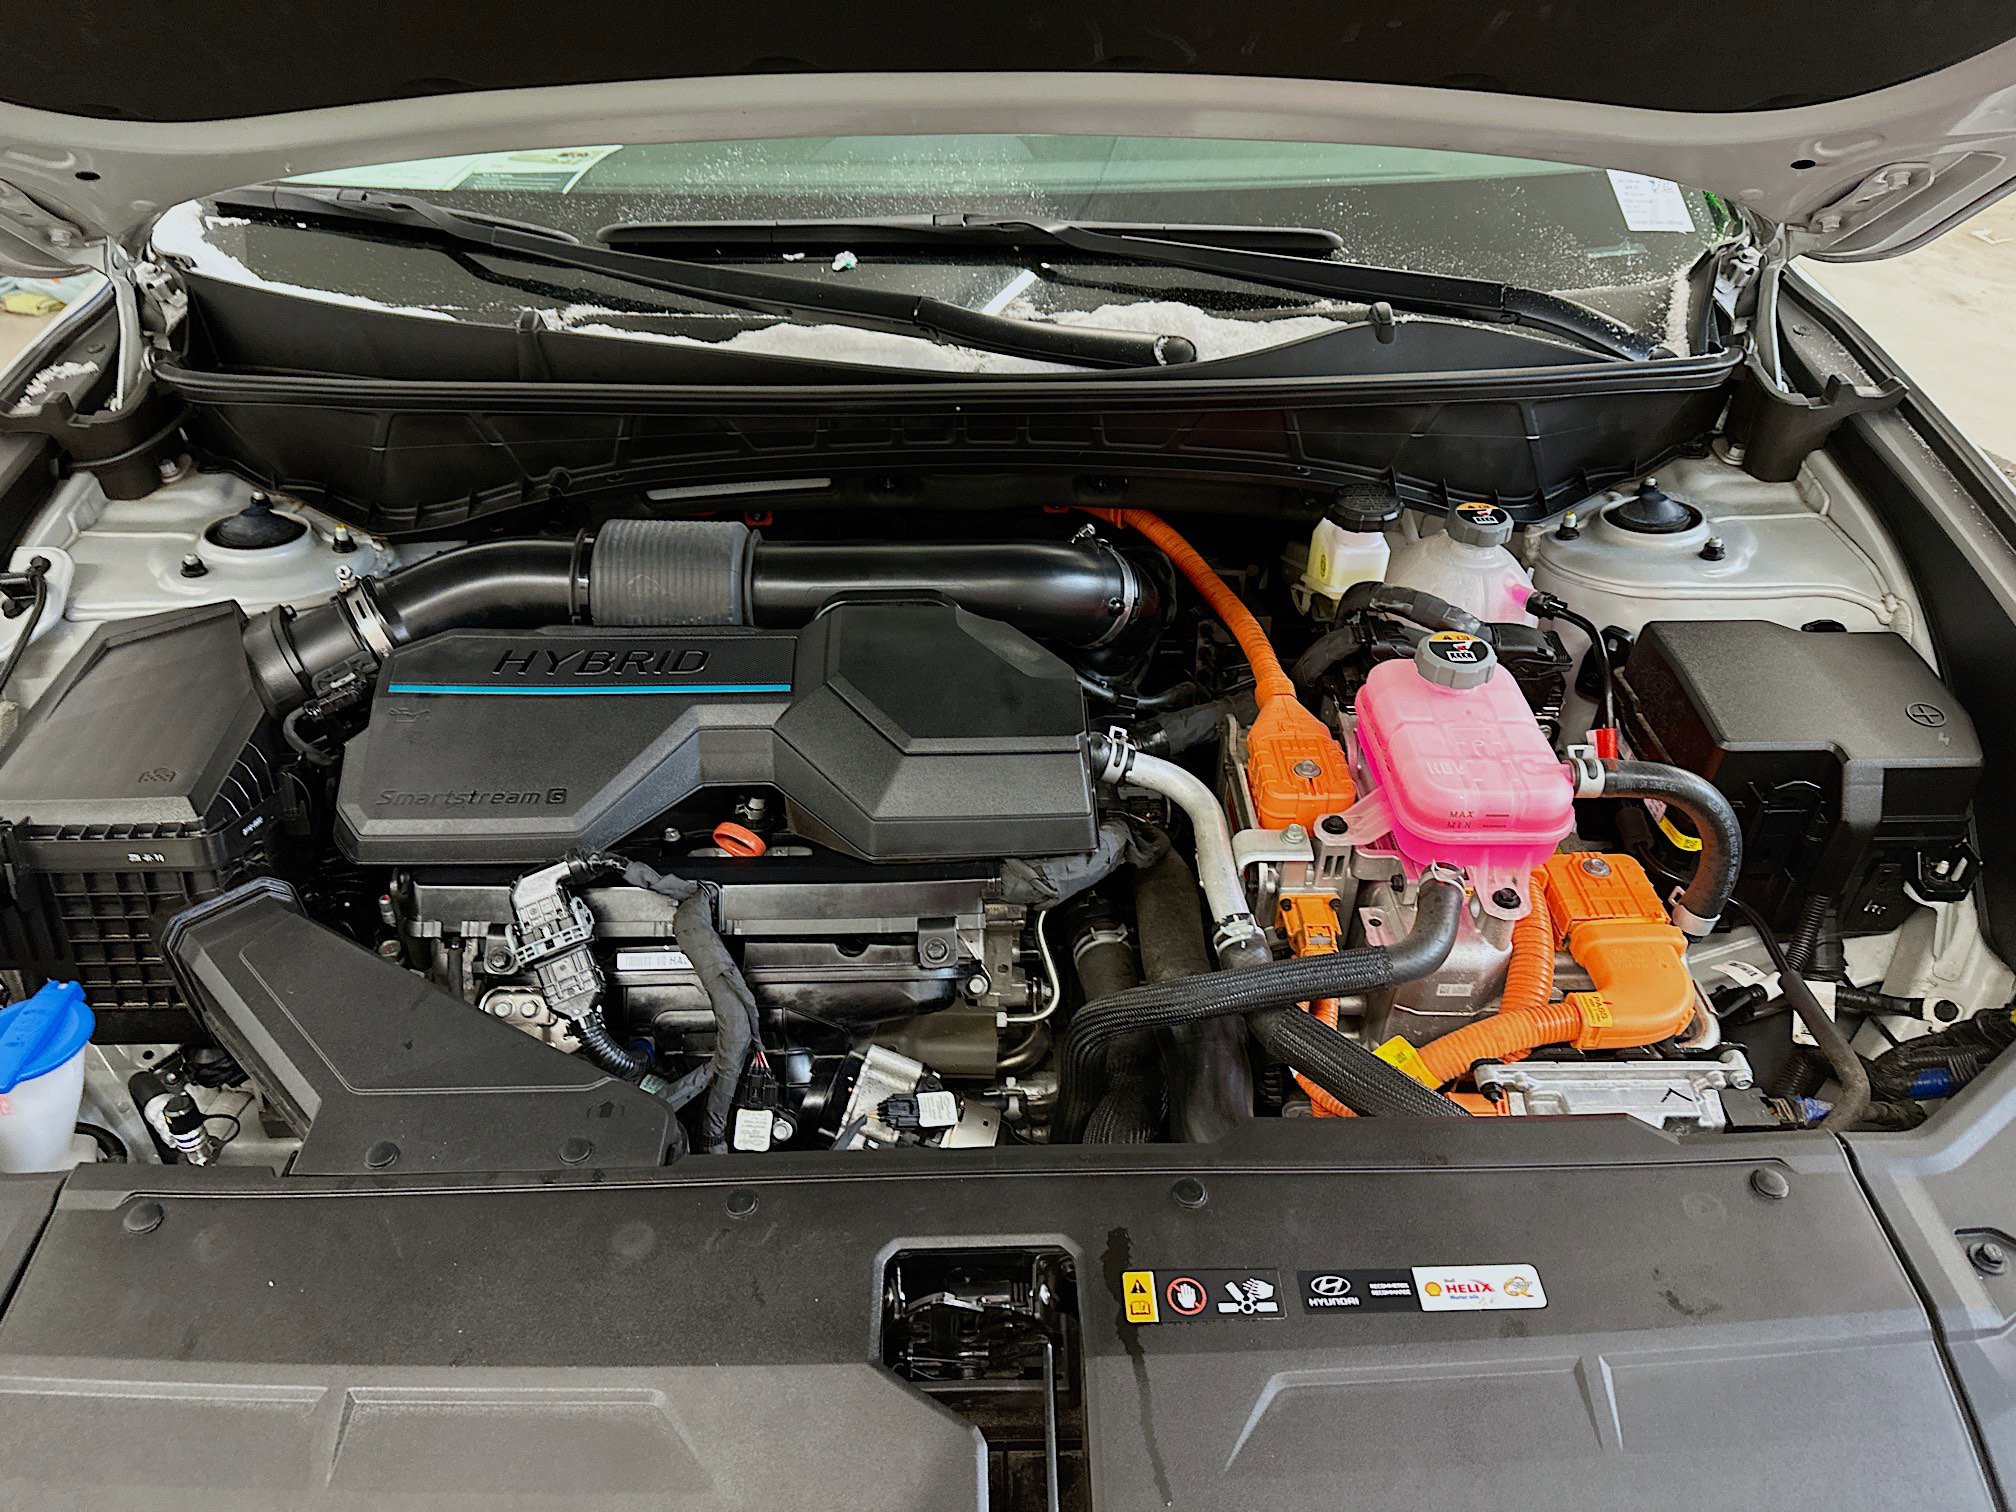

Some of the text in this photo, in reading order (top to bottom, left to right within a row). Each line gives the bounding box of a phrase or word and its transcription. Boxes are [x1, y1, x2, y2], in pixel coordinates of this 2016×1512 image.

[491, 649, 711, 676] HYBRID
[376, 789, 541, 806] Smartstream
[1447, 821, 1472, 829] MIN
[1445, 1283, 1494, 1293] HELIX
[1308, 1297, 1361, 1307] HYUNDAI
